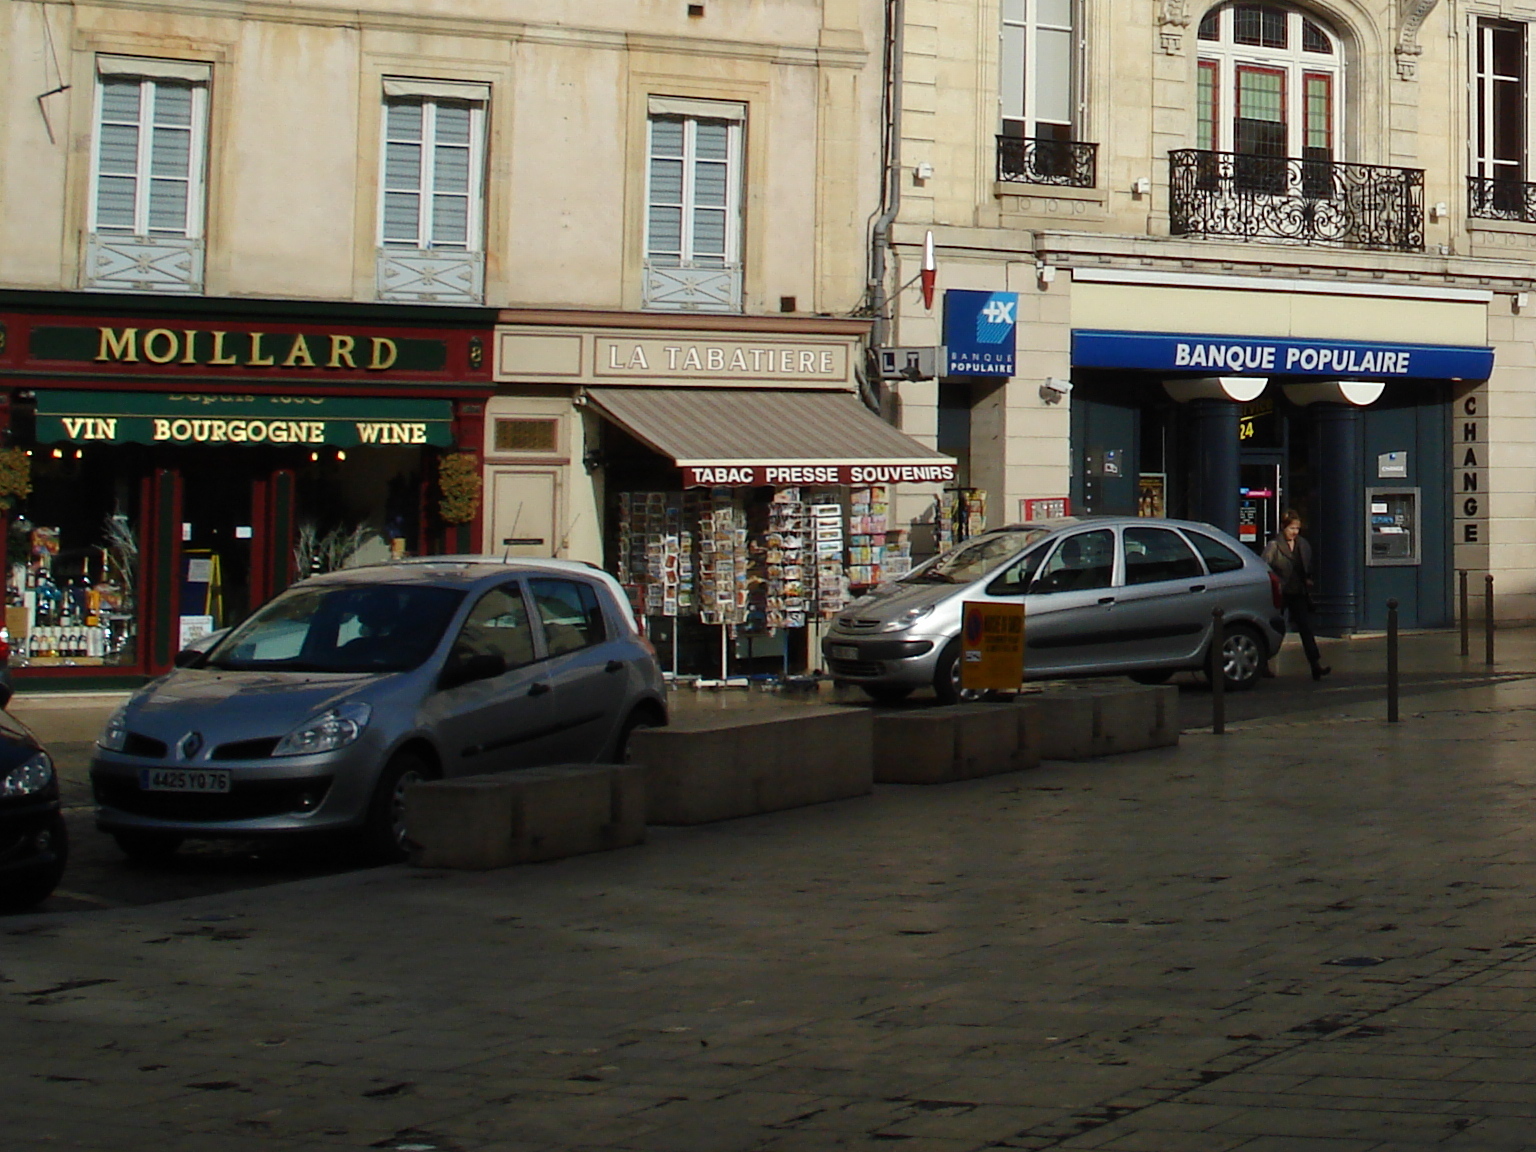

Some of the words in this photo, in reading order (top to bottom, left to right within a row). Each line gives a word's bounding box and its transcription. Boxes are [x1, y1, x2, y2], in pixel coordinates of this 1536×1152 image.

[95, 327, 398, 370] MOILLARD
[609, 345, 649, 370] LA
[663, 346, 834, 374] TABATIERE
[951, 352, 1012, 361] BANQUE
[1175, 343, 1276, 370] BANQUE
[1286, 348, 1410, 374] POPULAIRE
[951, 363, 1012, 373] POPULAIRE
[62, 417, 118, 440] VIN
[153, 419, 325, 443] BOURGOGNE
[357, 422, 426, 443] WINE
[1240, 422, 1254, 439] 24
[692, 467, 754, 484] TABAC
[765, 467, 839, 483] PRESSE
[850, 466, 954, 482] SOUVENIRS
[1463, 396, 1478, 543] CHANGE
[208, 774, 227, 789] 76
